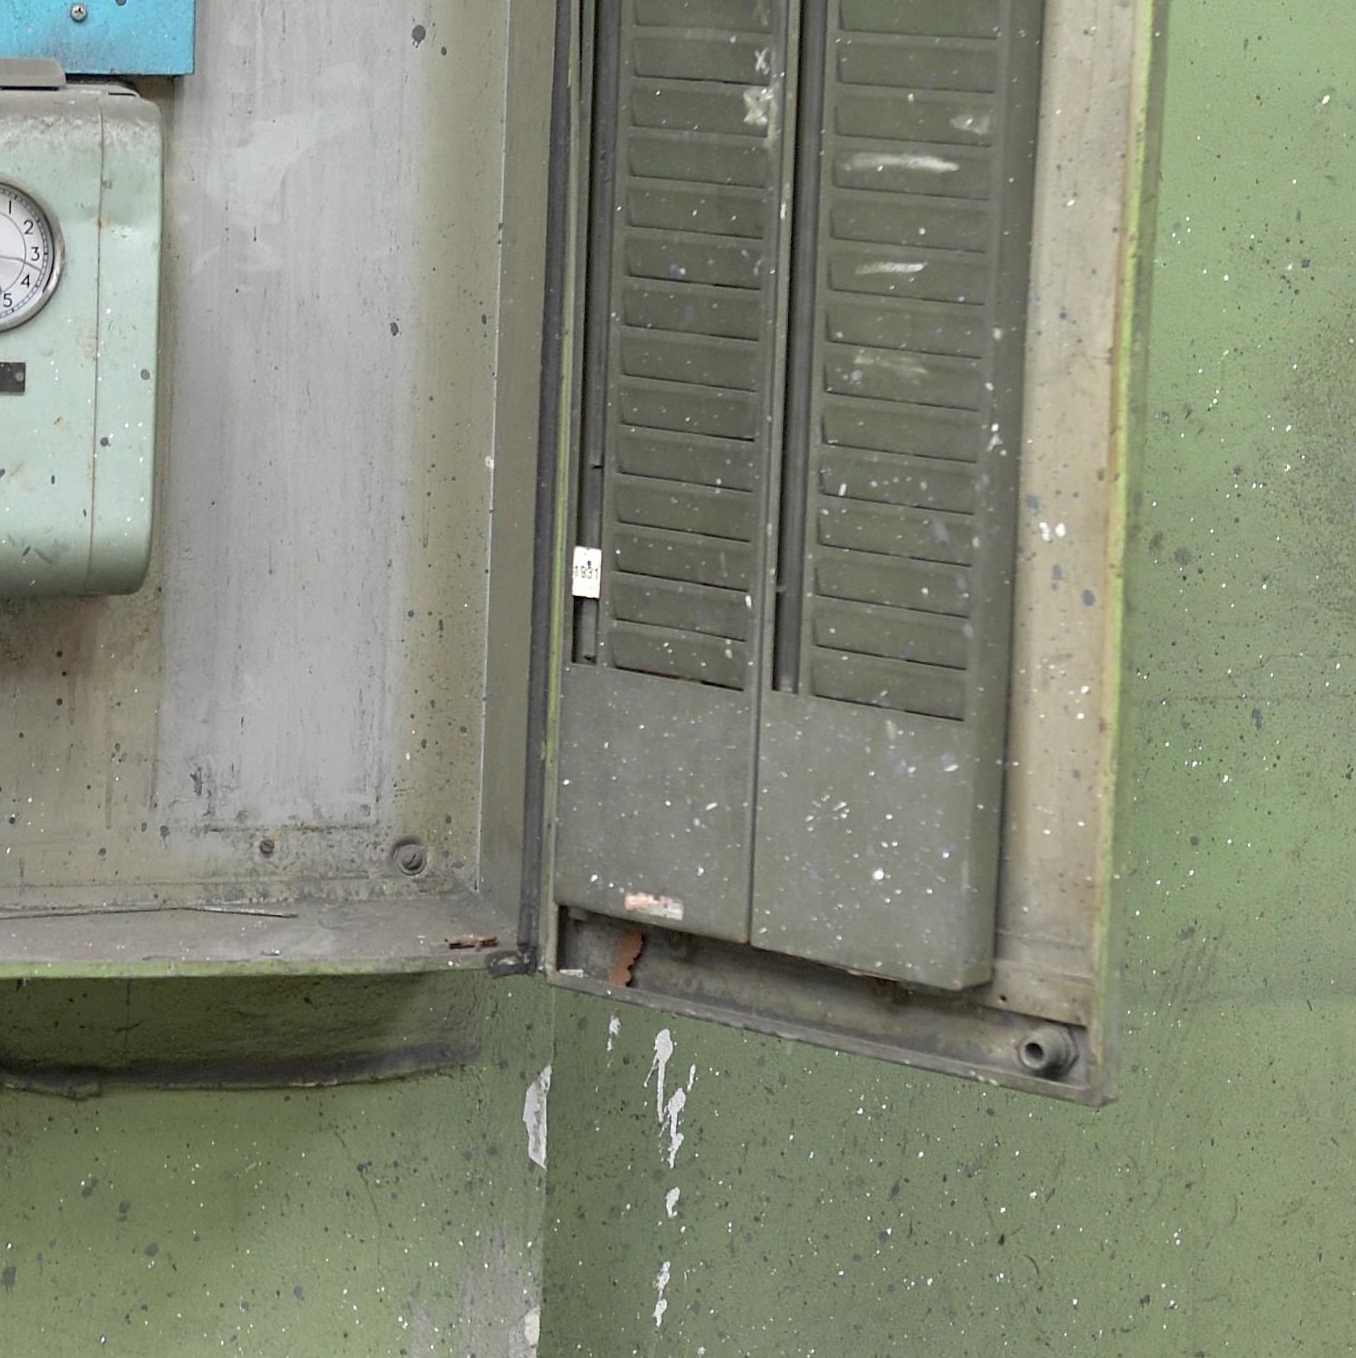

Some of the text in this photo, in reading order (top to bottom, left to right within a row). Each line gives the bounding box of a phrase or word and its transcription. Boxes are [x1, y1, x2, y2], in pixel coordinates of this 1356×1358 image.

[23, 219, 33, 234] 2
[31, 246, 40, 261] 3
[20, 274, 30, 288] 4
[3, 293, 13, 308] 5
